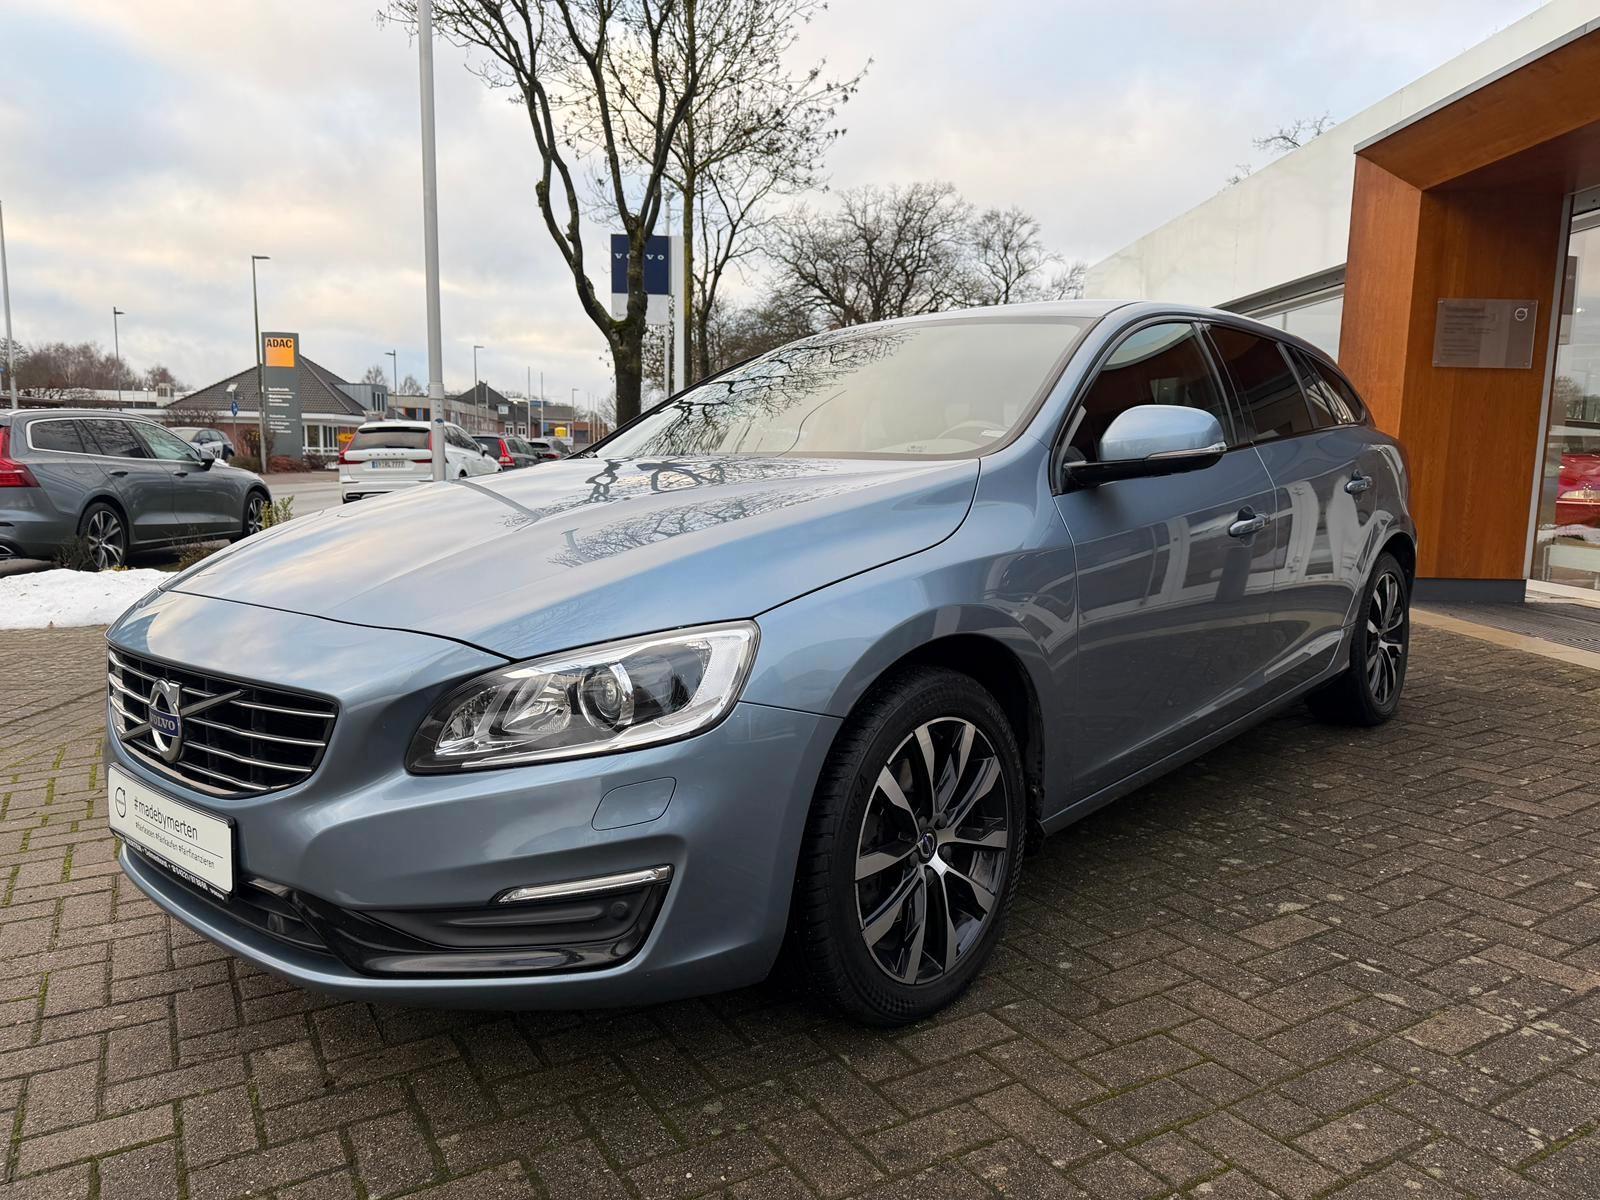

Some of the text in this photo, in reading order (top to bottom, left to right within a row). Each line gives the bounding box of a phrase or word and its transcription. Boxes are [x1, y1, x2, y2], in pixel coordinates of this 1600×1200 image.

[614, 252, 665, 261] VOVO
[266, 338, 293, 349] ADAC
[152, 712, 176, 731] VOLVO
[134, 795, 199, 841] #madebymerten
